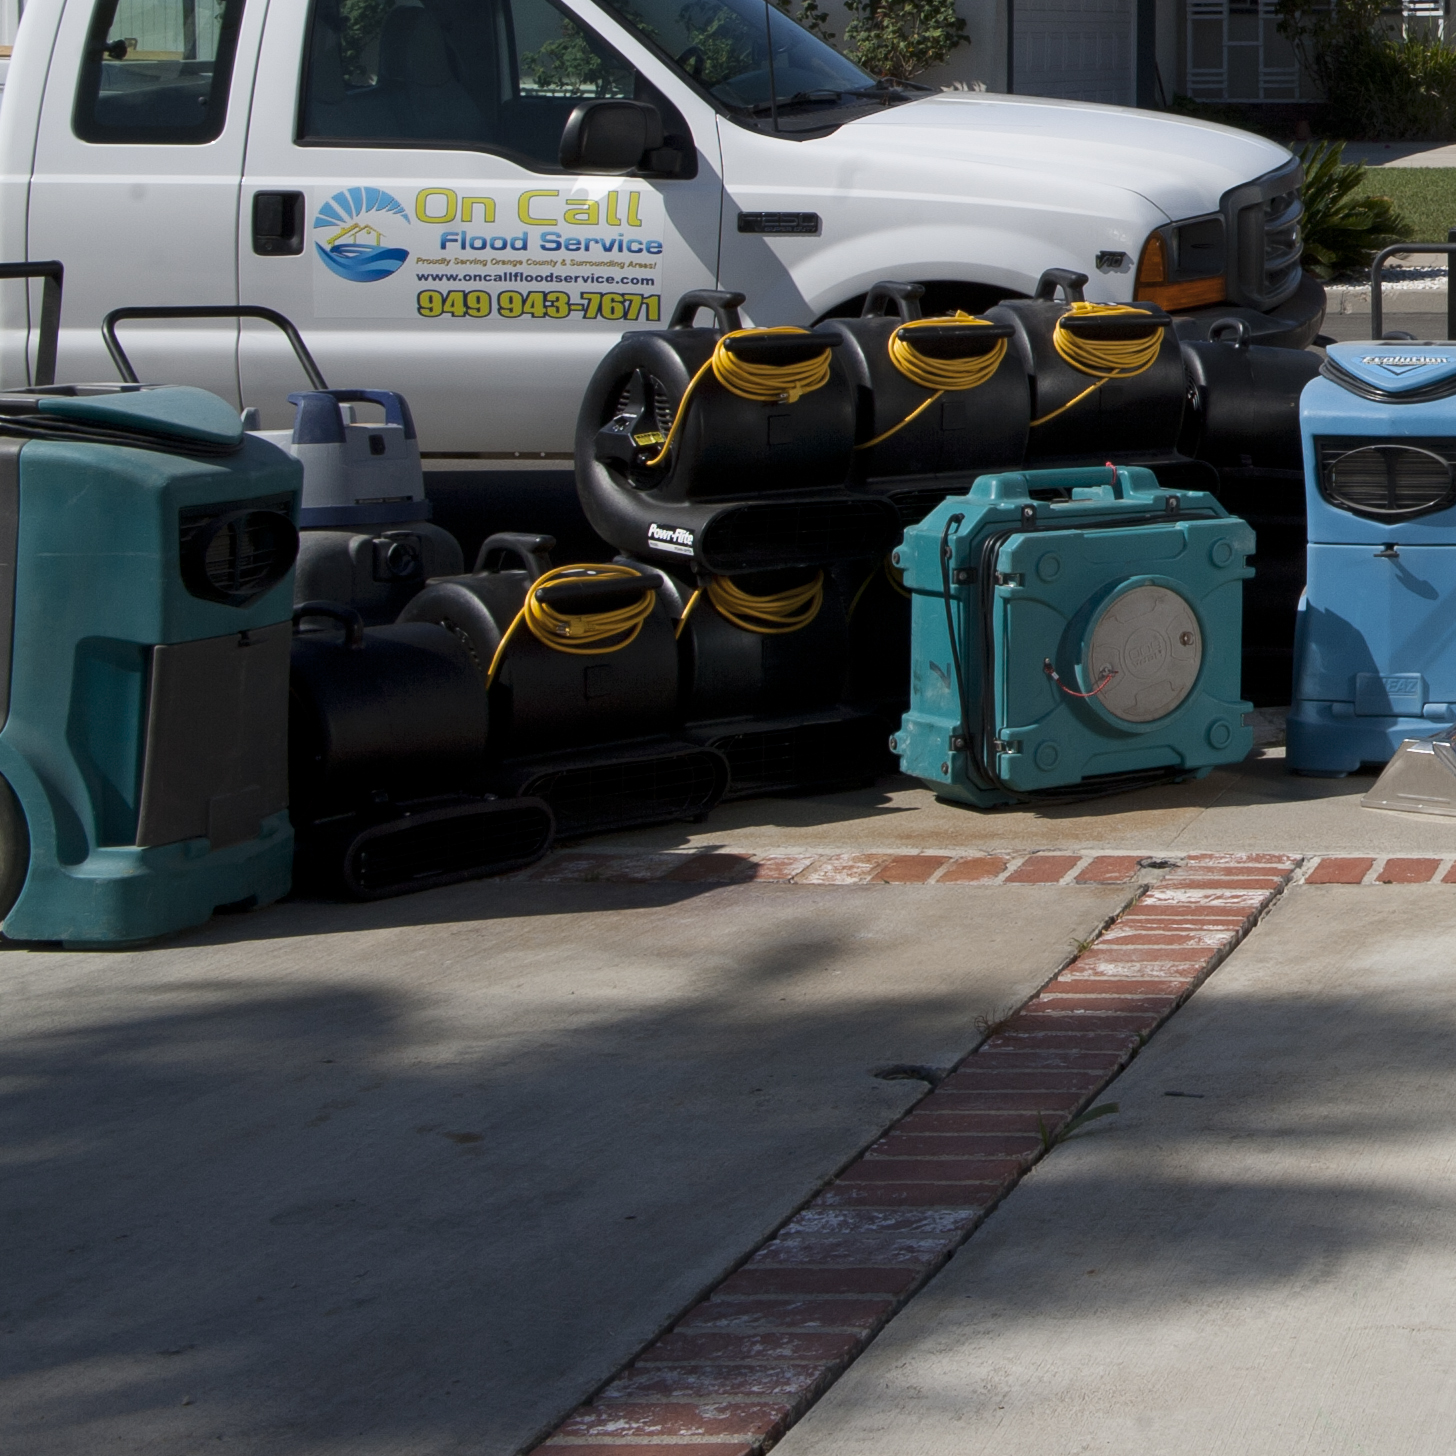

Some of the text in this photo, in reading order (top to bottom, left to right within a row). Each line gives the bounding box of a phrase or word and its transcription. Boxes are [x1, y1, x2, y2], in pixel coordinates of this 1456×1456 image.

[415, 187, 643, 228] On Call
[440, 230, 664, 255] Flood Service
[415, 257, 452, 267] Proudly
[453, 257, 488, 268] Serving
[490, 258, 523, 268] Orange
[526, 258, 558, 269] County
[569, 258, 626, 270] Surrounding
[627, 260, 658, 270] Areas!
[416, 271, 656, 286] www.oncallfloodservice.com
[417, 289, 662, 322] 949 943-7671
